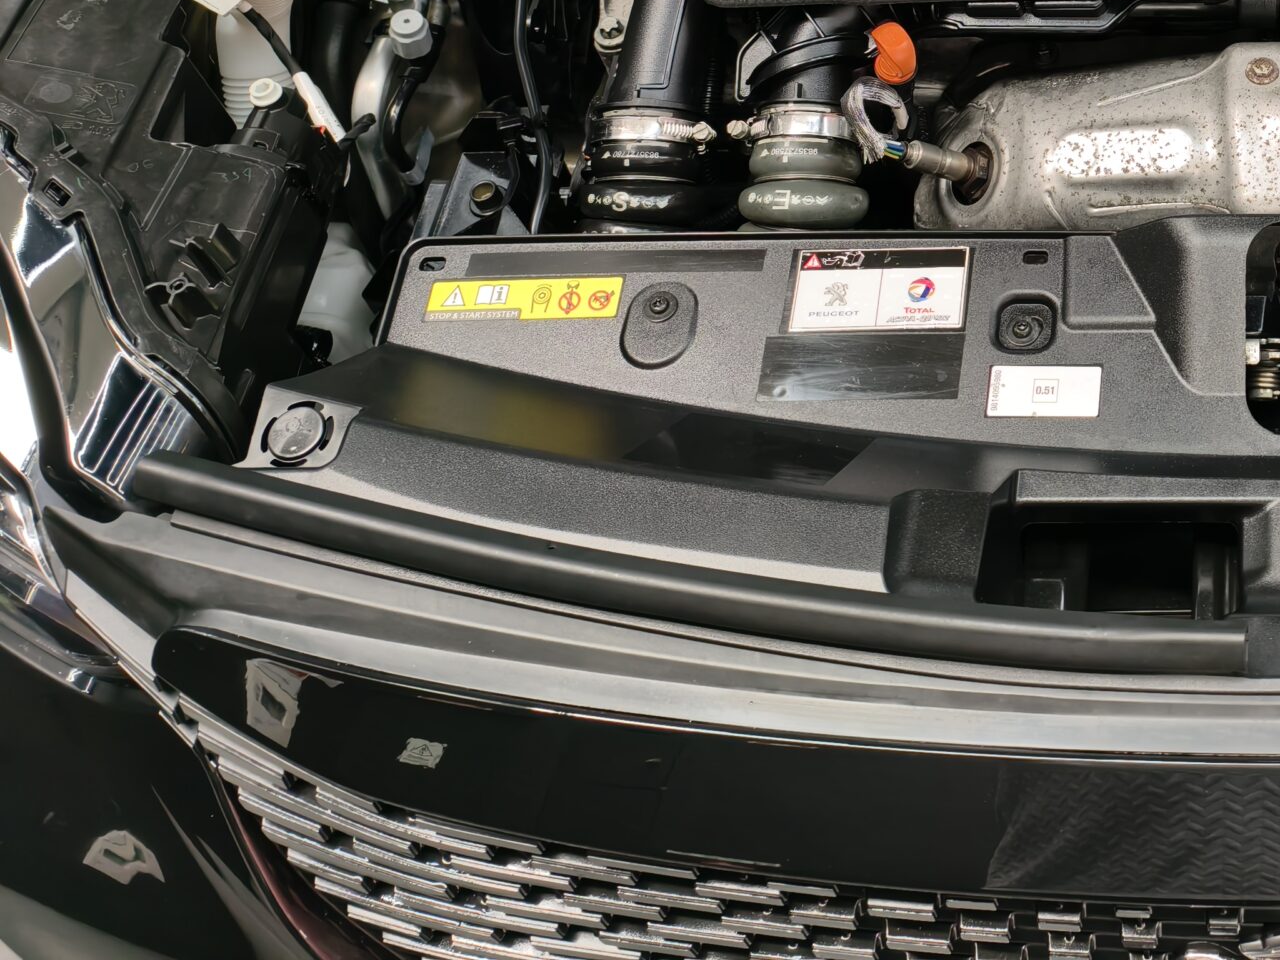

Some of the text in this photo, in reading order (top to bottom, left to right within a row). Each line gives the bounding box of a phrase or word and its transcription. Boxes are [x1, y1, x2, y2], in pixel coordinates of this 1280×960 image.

[428, 309, 519, 320] STOP & START SYSTEM
[1035, 386, 1055, 396] 0.51
